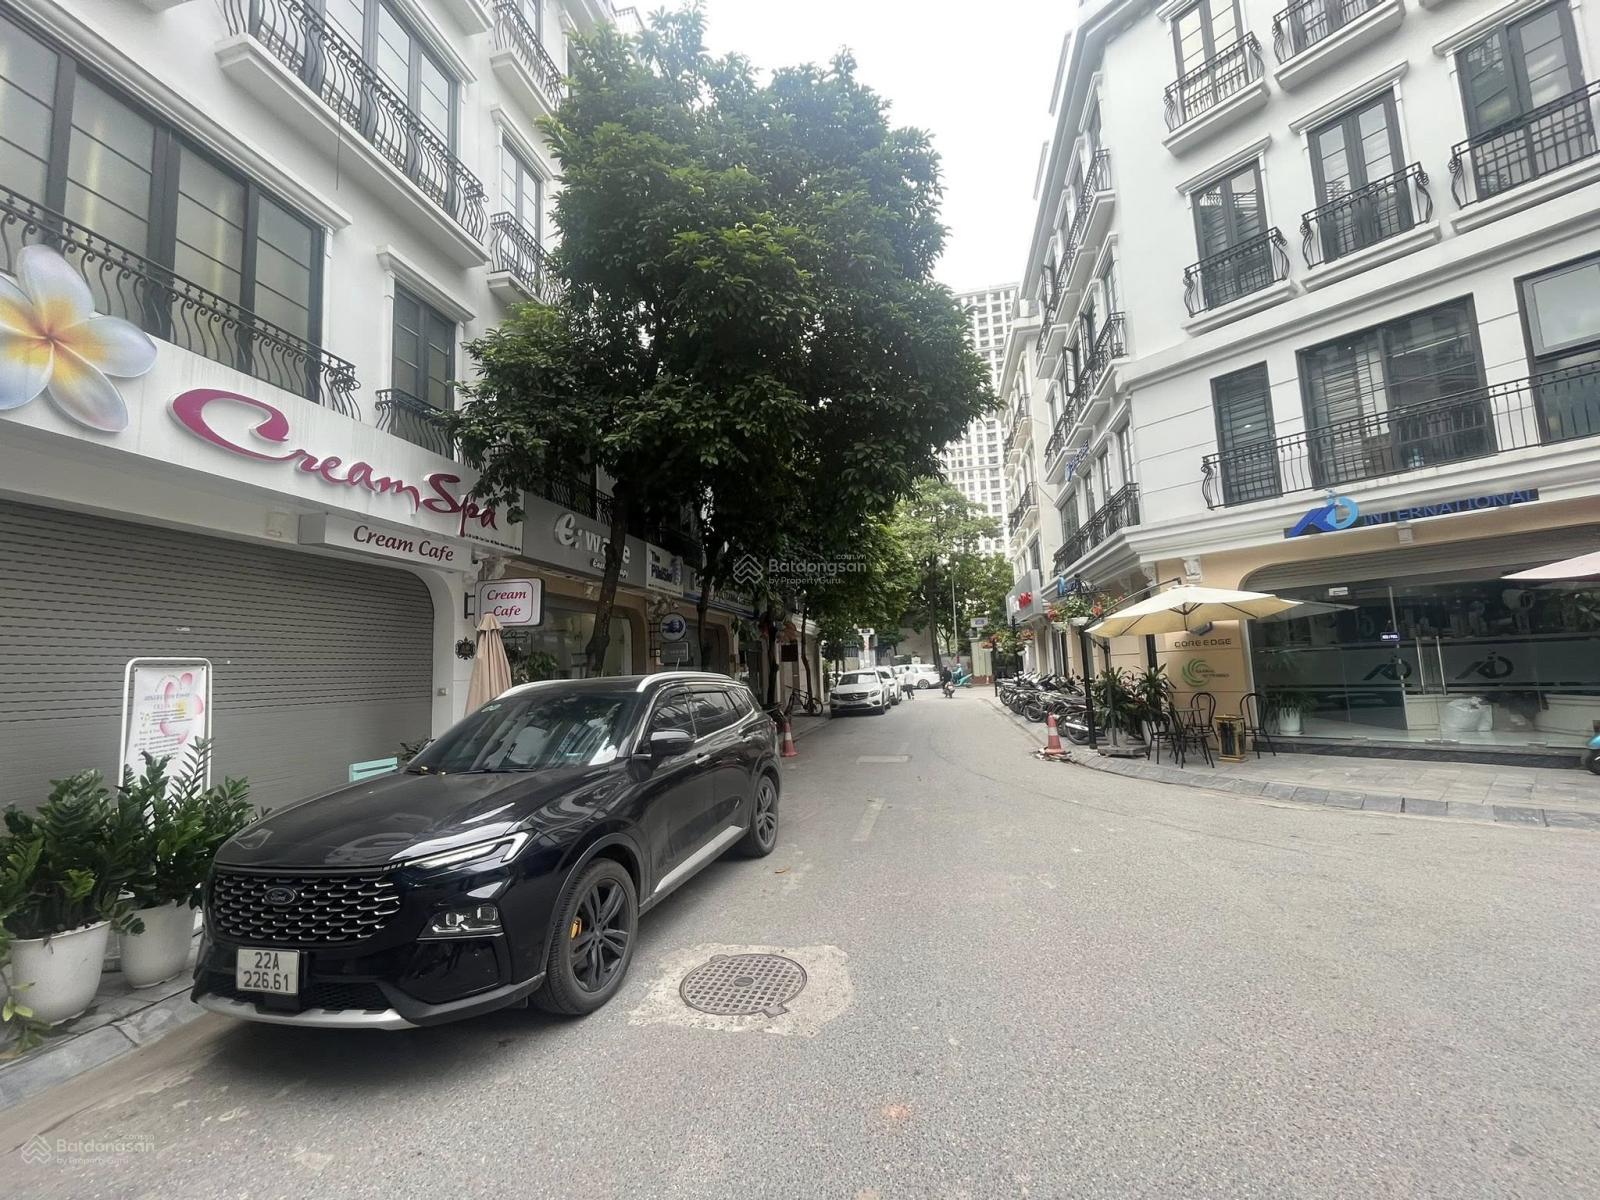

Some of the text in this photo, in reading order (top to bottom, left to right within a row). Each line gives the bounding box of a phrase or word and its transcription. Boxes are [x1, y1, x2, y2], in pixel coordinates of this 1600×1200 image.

[169, 388, 498, 537] Cream Spa
[1364, 490, 1539, 526] INTERNATIONAL
[353, 525, 414, 553] Cream
[418, 539, 454, 562] Cafe
[487, 590, 527, 601] Cream
[493, 605, 521, 617] Cafe
[254, 951, 280, 970] 22A
[243, 971, 289, 991] 226.61
